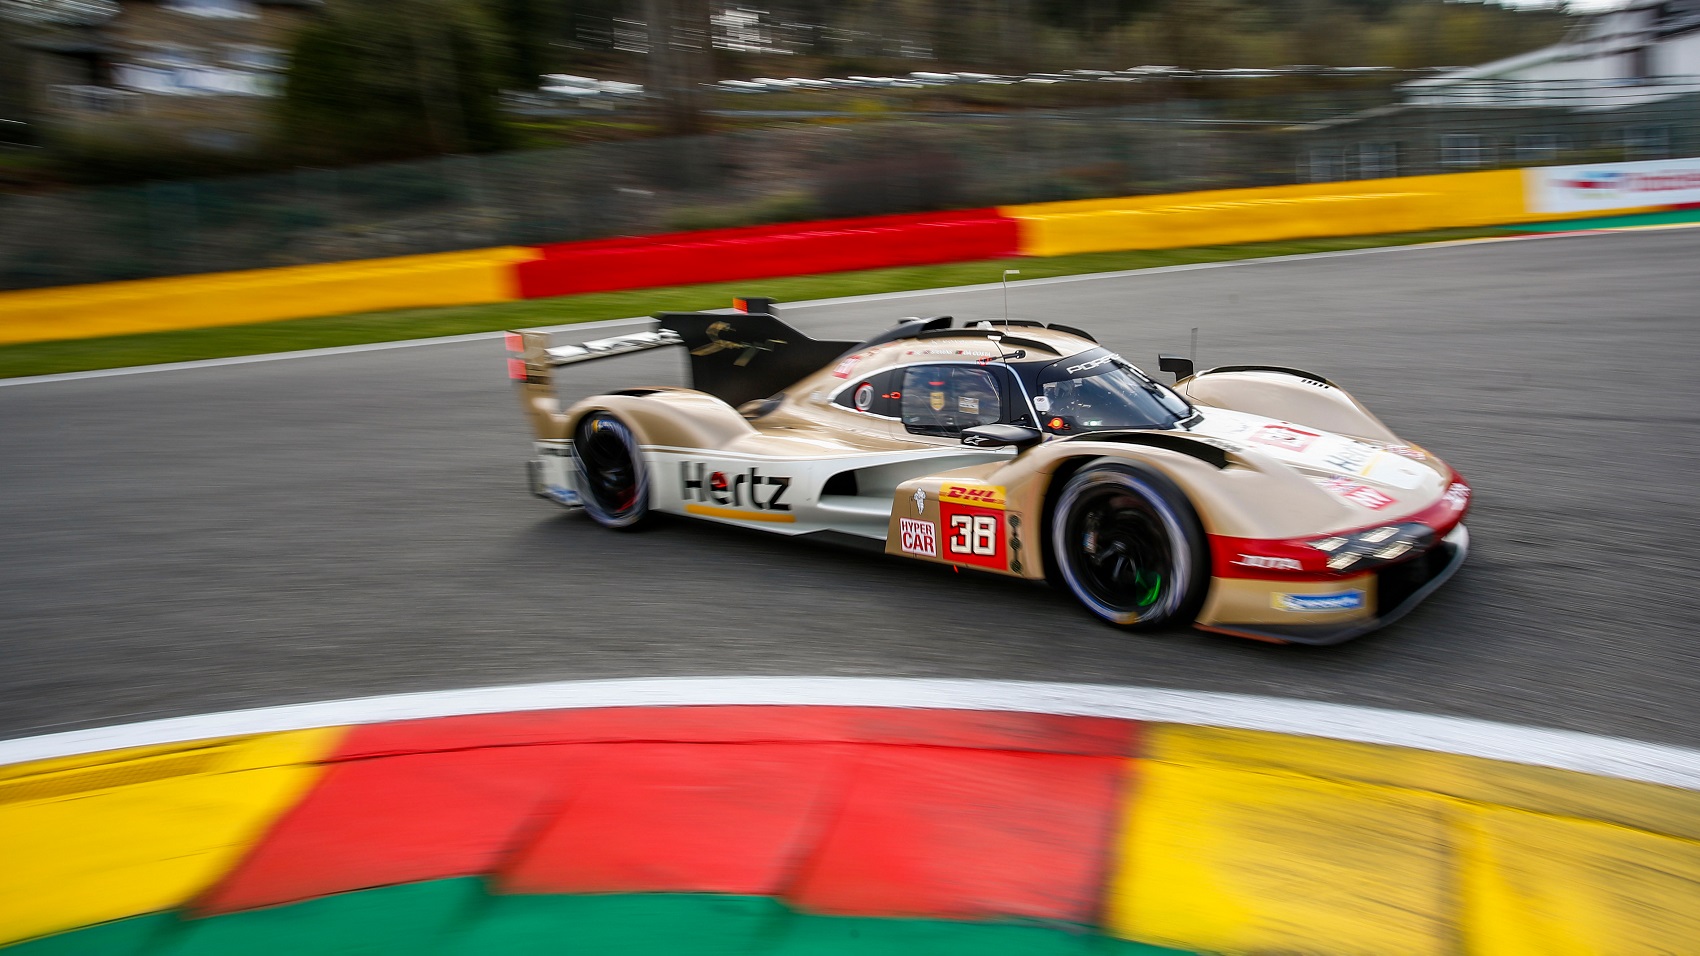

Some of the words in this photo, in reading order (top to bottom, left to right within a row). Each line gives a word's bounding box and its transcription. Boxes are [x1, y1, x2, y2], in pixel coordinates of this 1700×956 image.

[679, 460, 792, 511] Hertz
[945, 485, 996, 503] DHL
[901, 518, 932, 536] HYPER
[948, 512, 998, 556] 38
[902, 531, 934, 554] CAR
